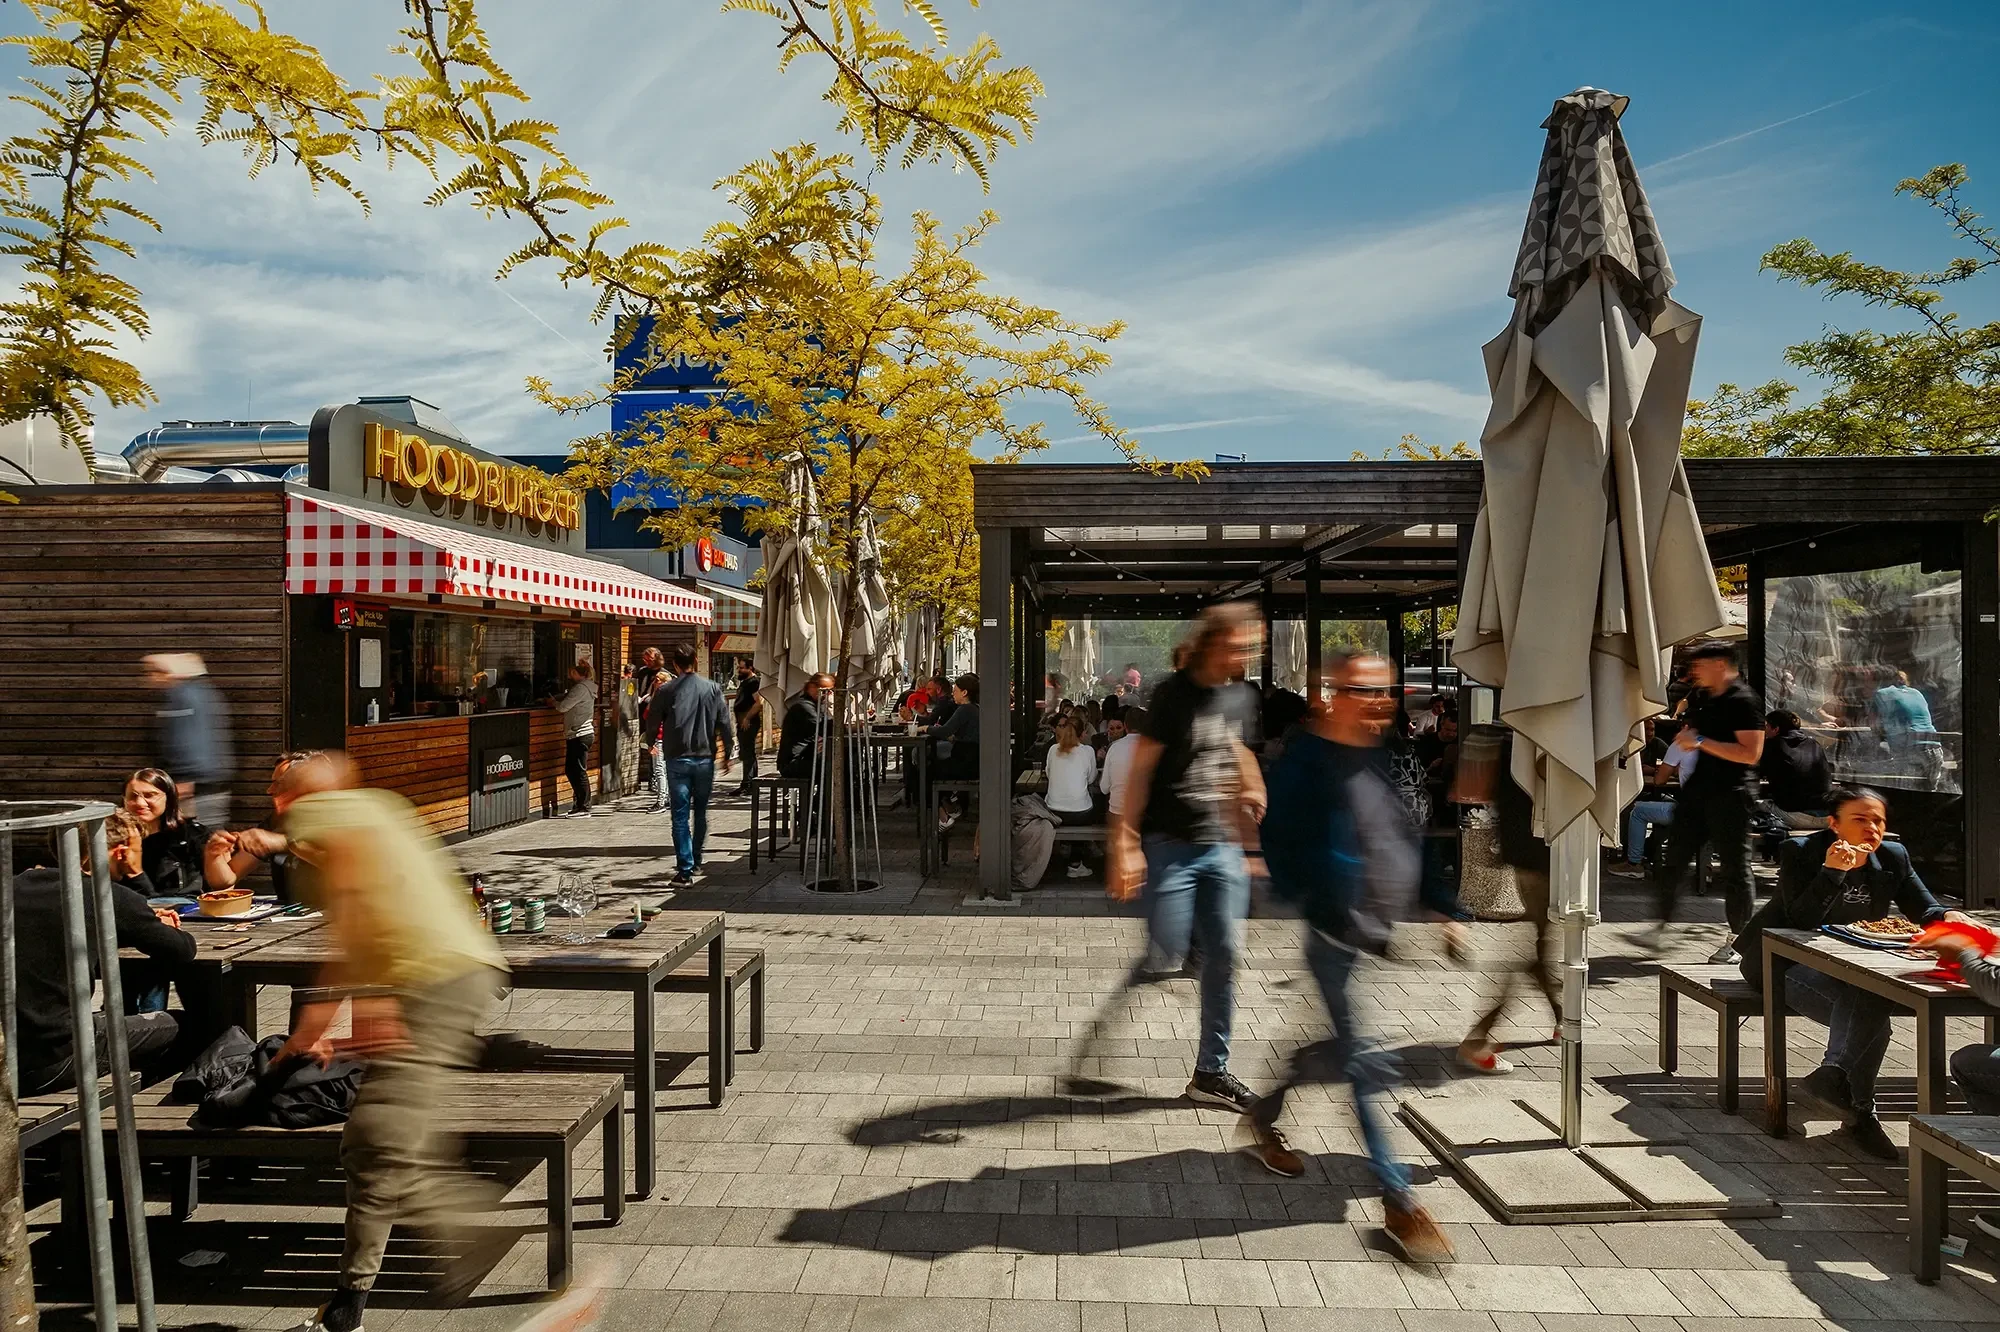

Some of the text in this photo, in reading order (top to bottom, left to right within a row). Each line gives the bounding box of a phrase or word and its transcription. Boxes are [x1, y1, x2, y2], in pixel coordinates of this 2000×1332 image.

[364, 422, 579, 530] HOODBURGER
[364, 611, 383, 621] Pick Up
[486, 760, 524, 775] HOODBURGER
